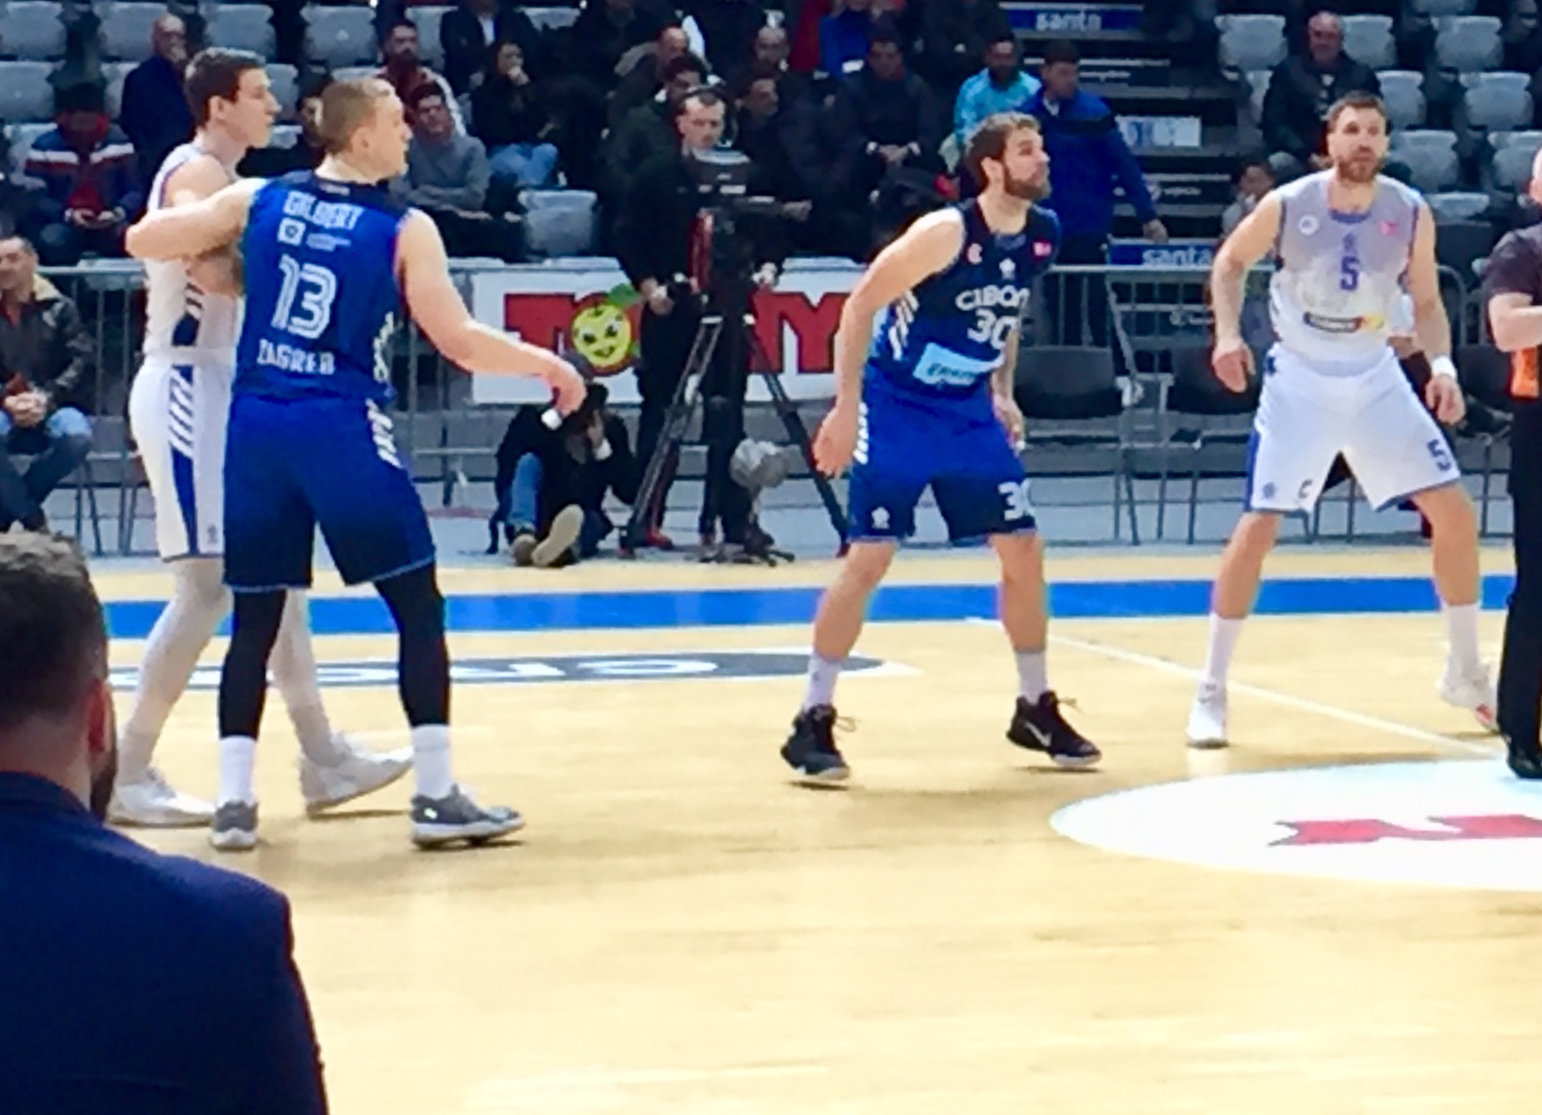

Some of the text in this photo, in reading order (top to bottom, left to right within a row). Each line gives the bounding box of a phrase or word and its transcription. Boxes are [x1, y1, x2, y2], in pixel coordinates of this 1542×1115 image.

[1340, 256, 1359, 292] 5
[270, 253, 337, 339] 13
[1427, 438, 1452, 473] 5
